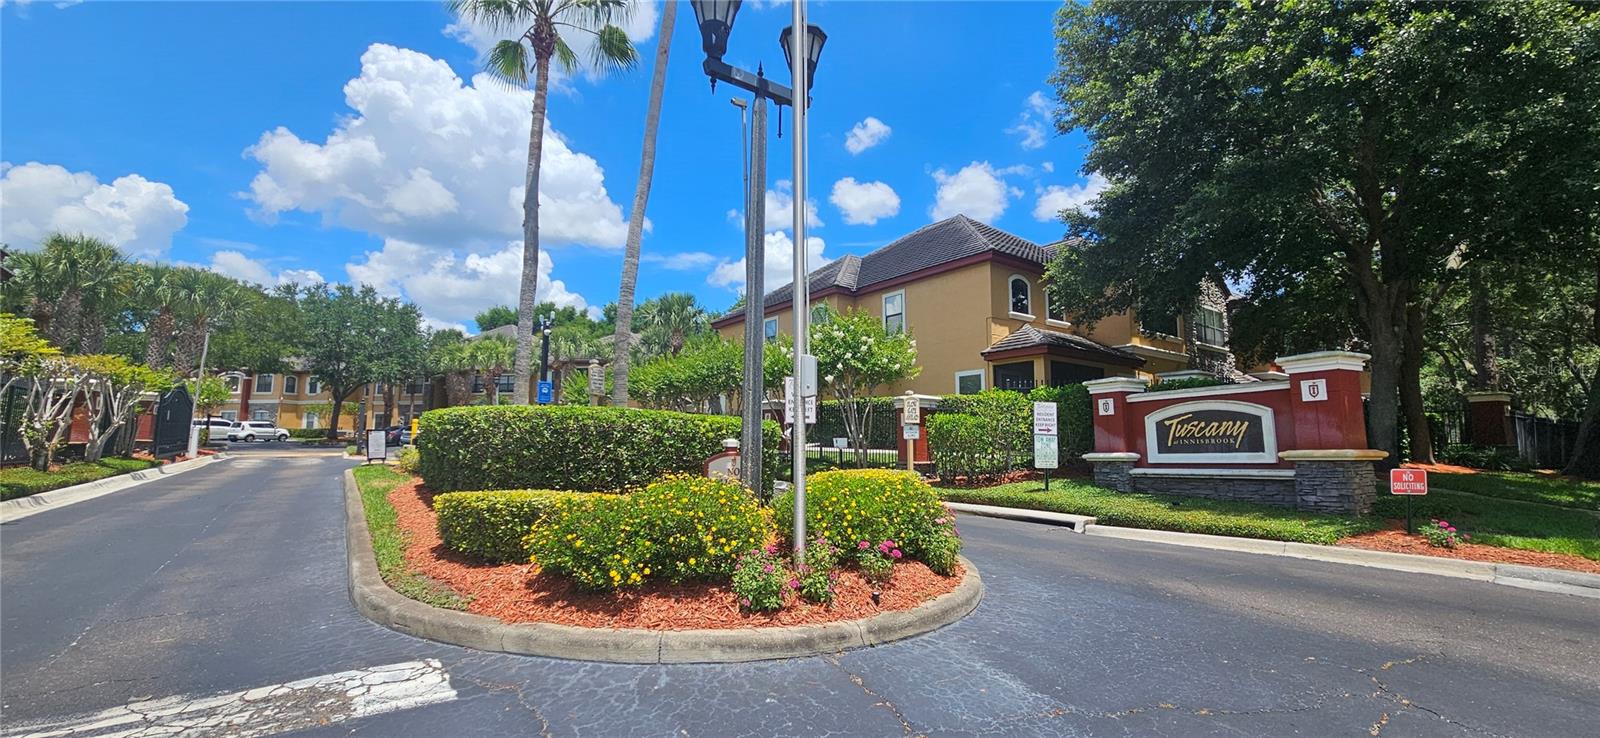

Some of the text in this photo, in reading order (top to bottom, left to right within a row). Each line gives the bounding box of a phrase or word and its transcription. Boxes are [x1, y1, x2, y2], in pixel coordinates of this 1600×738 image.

[1164, 413, 1249, 449] Tuscany
[1402, 473, 1414, 481] NO
[1393, 482, 1425, 490] SOLICITING
